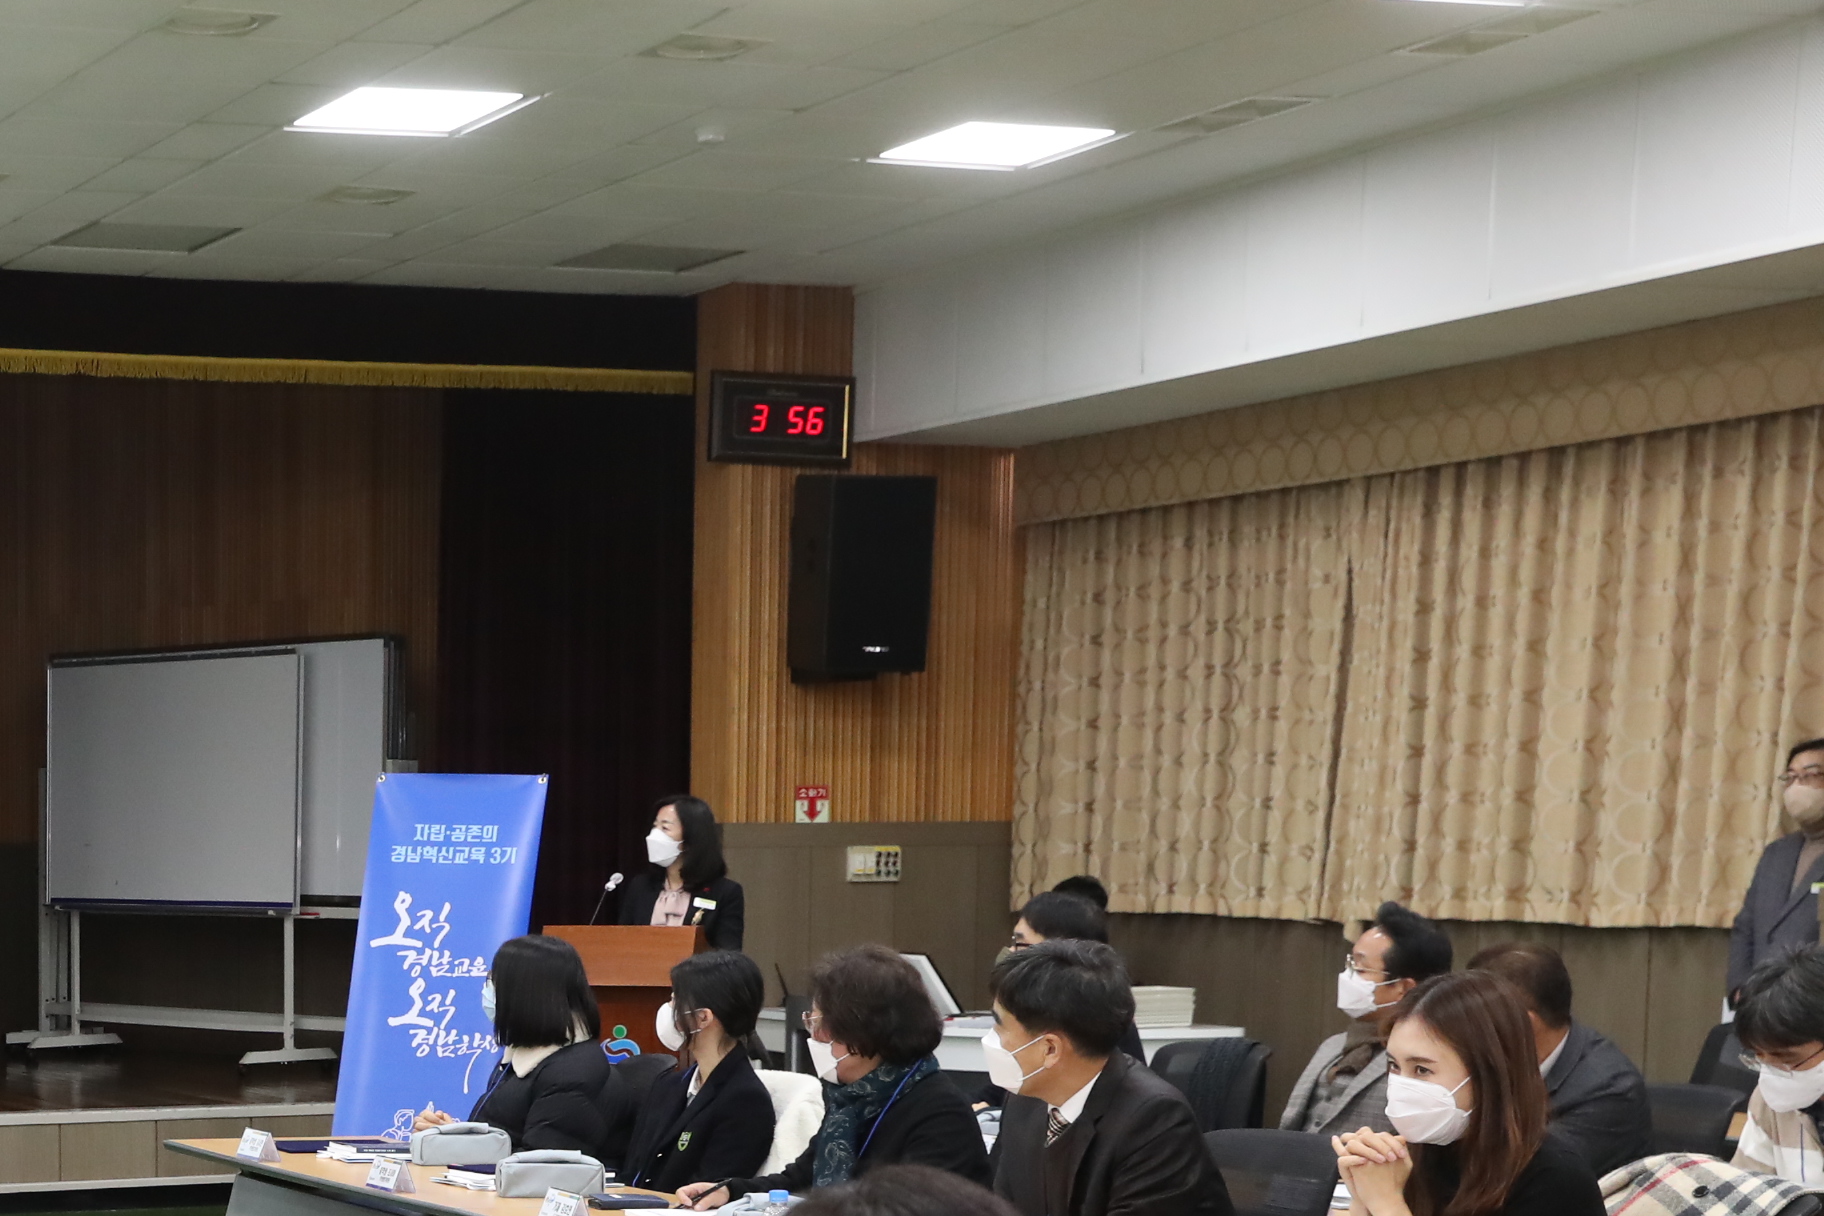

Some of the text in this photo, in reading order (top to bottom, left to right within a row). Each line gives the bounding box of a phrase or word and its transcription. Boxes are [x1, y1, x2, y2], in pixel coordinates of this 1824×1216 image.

[749, 403, 826, 435] 3 56
[413, 823, 499, 843] 자립·공존의
[390, 845, 518, 864] 경남혁신교육 3기
[369, 890, 452, 949] 오직
[386, 977, 456, 1030] 오직
